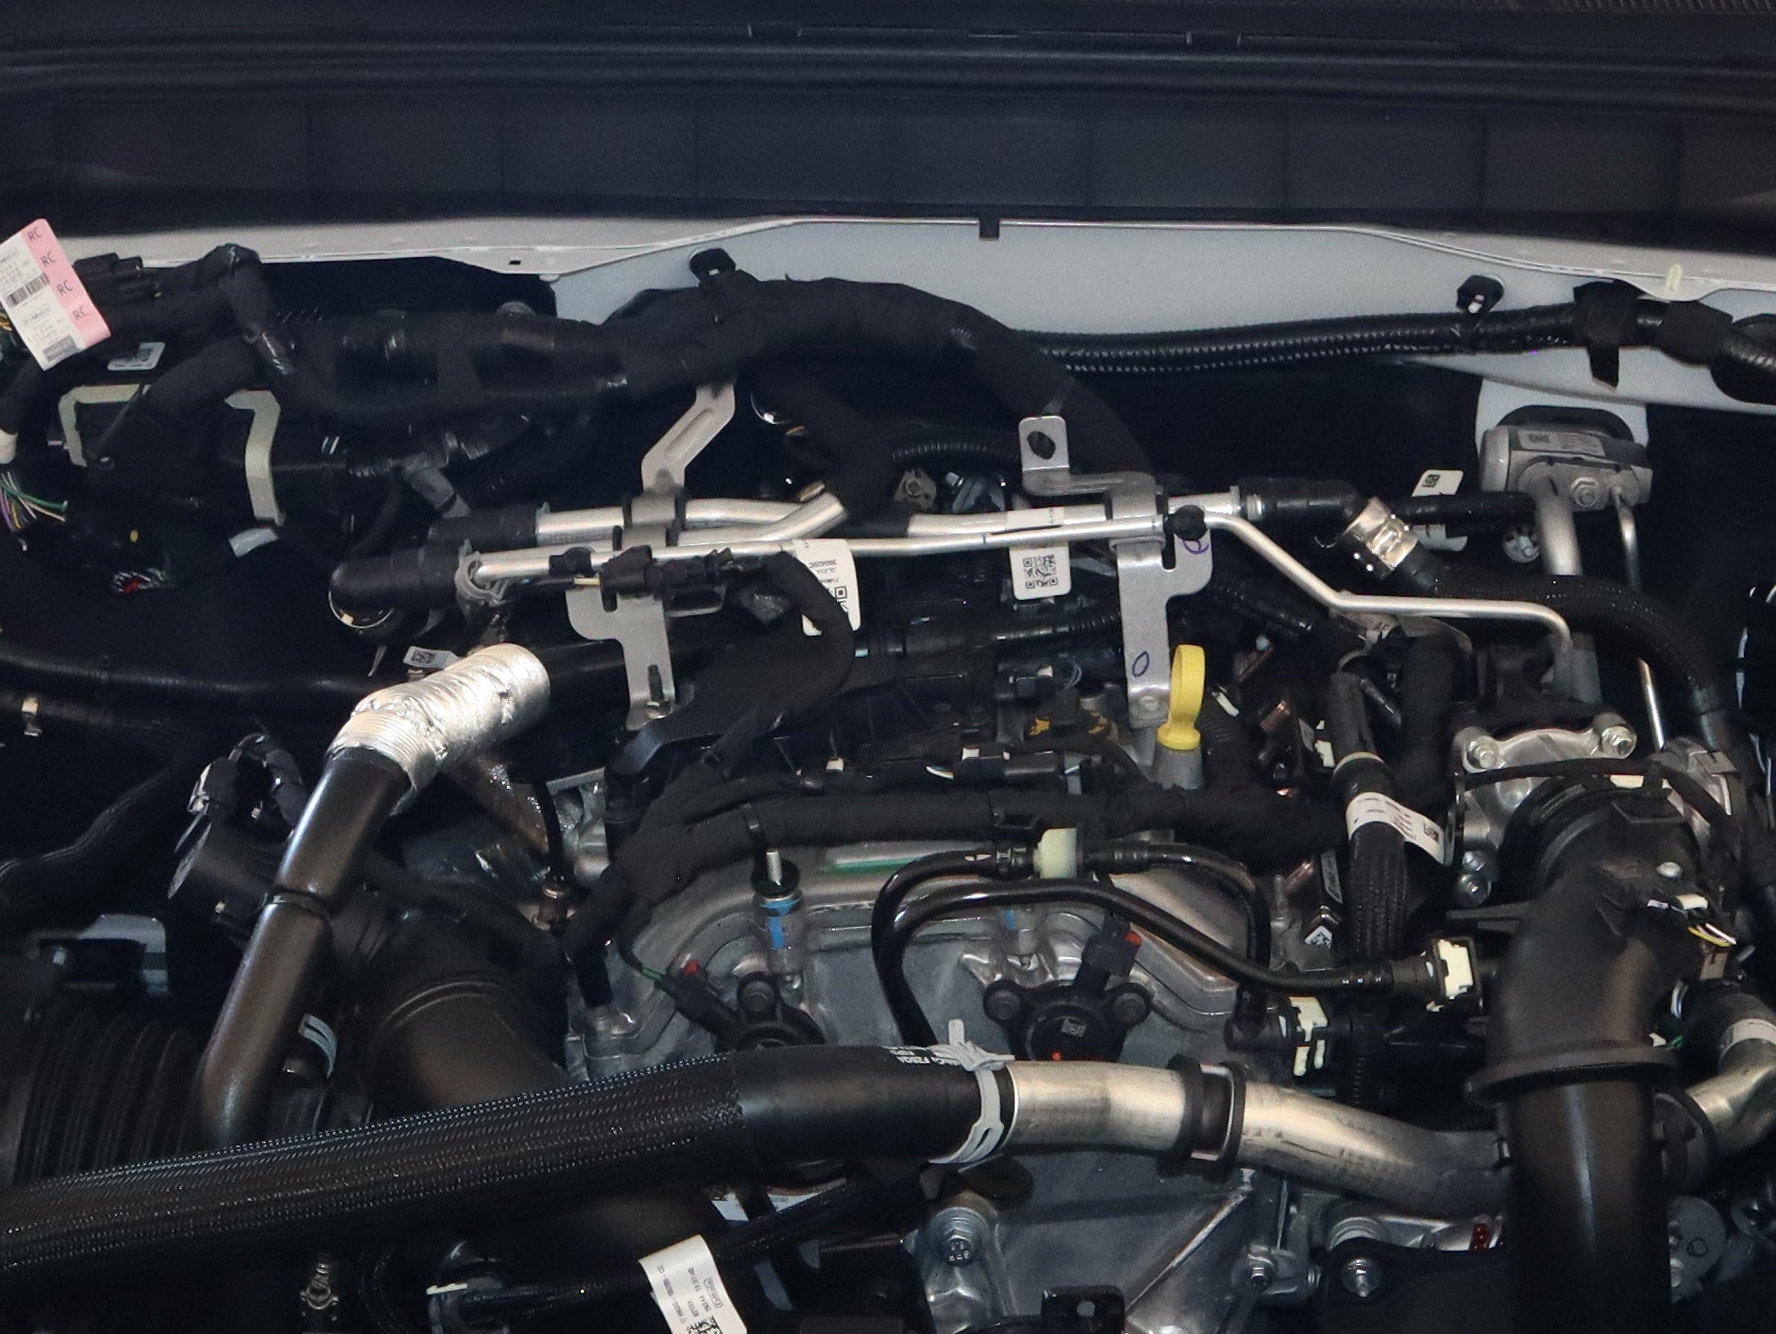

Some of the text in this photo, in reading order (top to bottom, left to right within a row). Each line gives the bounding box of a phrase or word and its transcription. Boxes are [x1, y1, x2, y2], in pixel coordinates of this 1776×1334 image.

[27, 227, 43, 242] RC
[40, 250, 56, 267] RC
[56, 280, 74, 296] RC
[72, 305, 88, 321] RC
